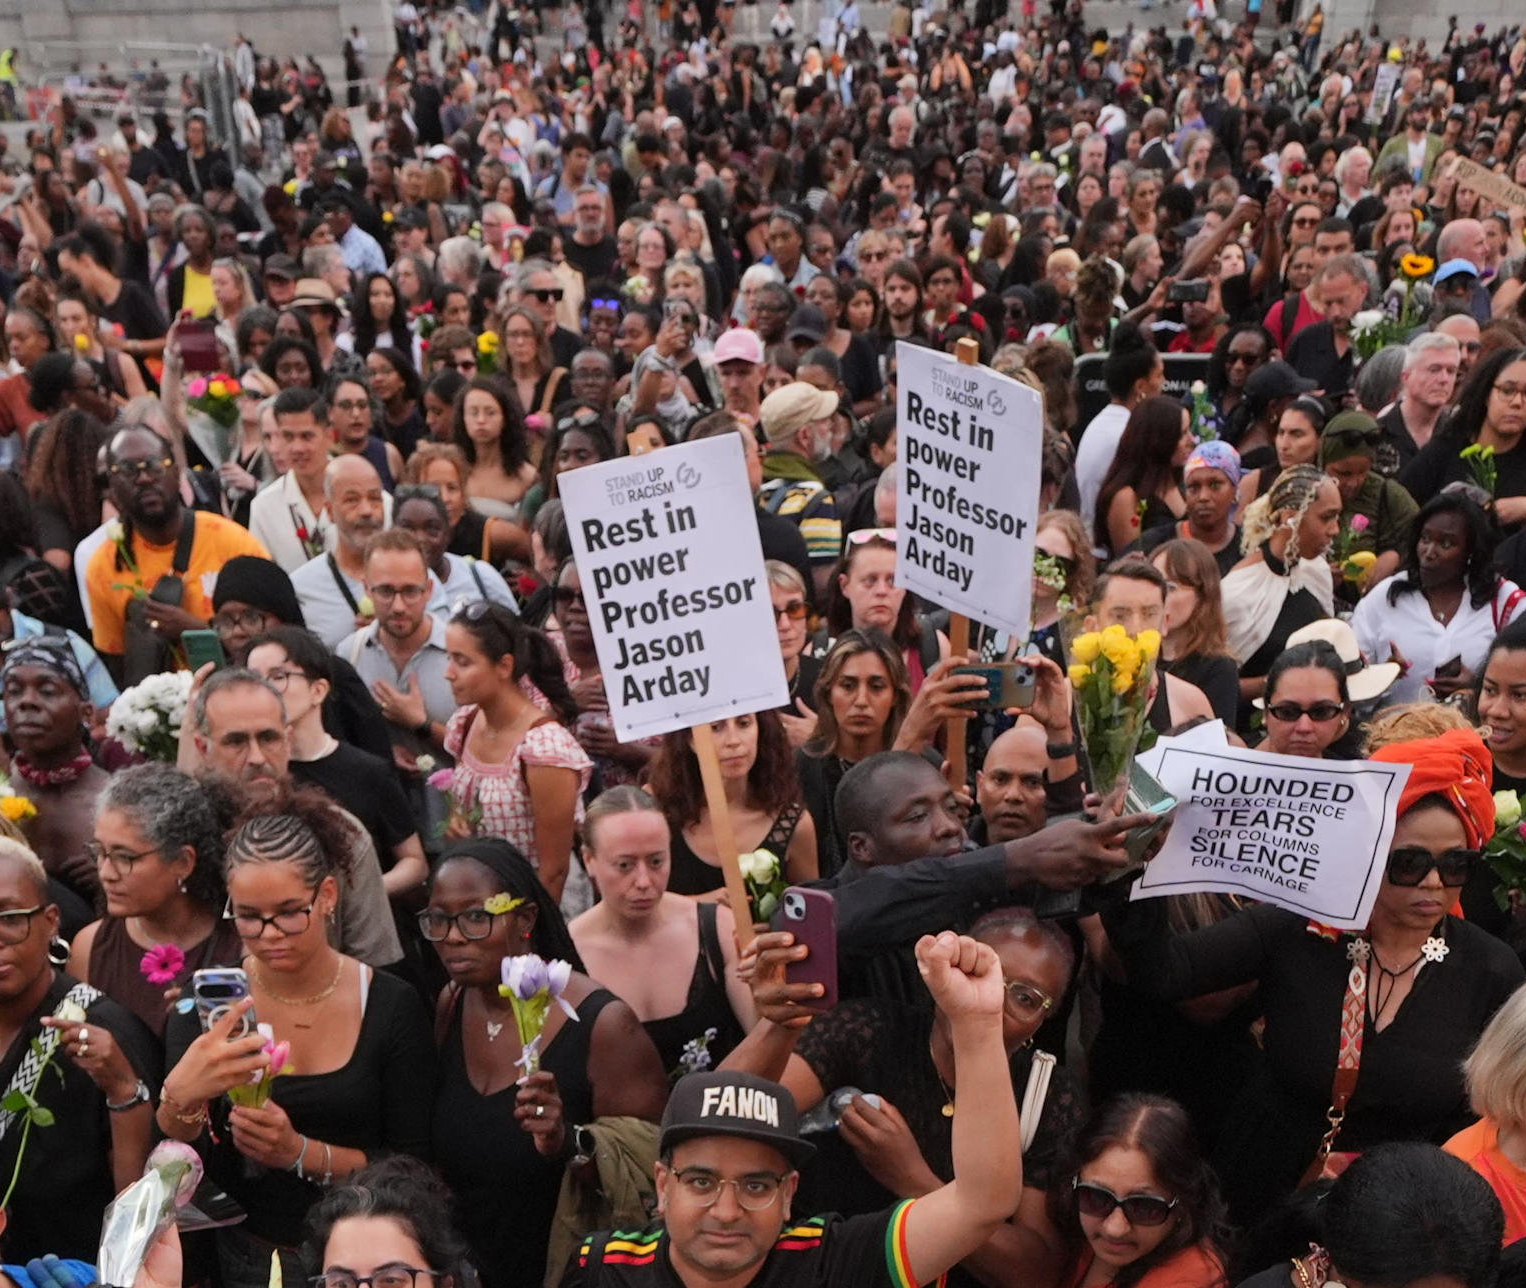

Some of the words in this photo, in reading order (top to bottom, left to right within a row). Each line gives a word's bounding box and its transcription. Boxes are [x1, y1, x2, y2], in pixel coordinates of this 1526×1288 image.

[931, 367, 962, 389] STAND
[963, 378, 979, 393] UP
[931, 381, 944, 398] TO
[945, 388, 983, 411] RACISM
[907, 390, 961, 441] Rest
[969, 415, 994, 451] in
[605, 471, 645, 493] STAND
[647, 467, 665, 483] UP
[906, 435, 981, 483] power
[609, 493, 625, 506] TO
[627, 481, 675, 503] RACISM
[906, 467, 1027, 540] Professor
[581, 508, 658, 552] Rest
[664, 502, 696, 534] in
[905, 504, 975, 557] Jason
[592, 547, 689, 599] power
[905, 536, 974, 592] Arday
[601, 576, 756, 634] Professor
[614, 628, 704, 670] Jason
[623, 665, 710, 707] Arday
[1191, 767, 1354, 803] HOUNDED
[1190, 795, 1225, 808] FOR
[1230, 797, 1347, 820] EXCELLENCE
[1211, 809, 1316, 837] TEARS
[1190, 835, 1320, 880] SILENCE
[1198, 826, 1231, 839] FOR
[1237, 829, 1320, 856] COLUMNS
[1191, 856, 1225, 869] FOR
[1229, 862, 1309, 894] CARNAGE
[700, 1085, 779, 1127] FANON
